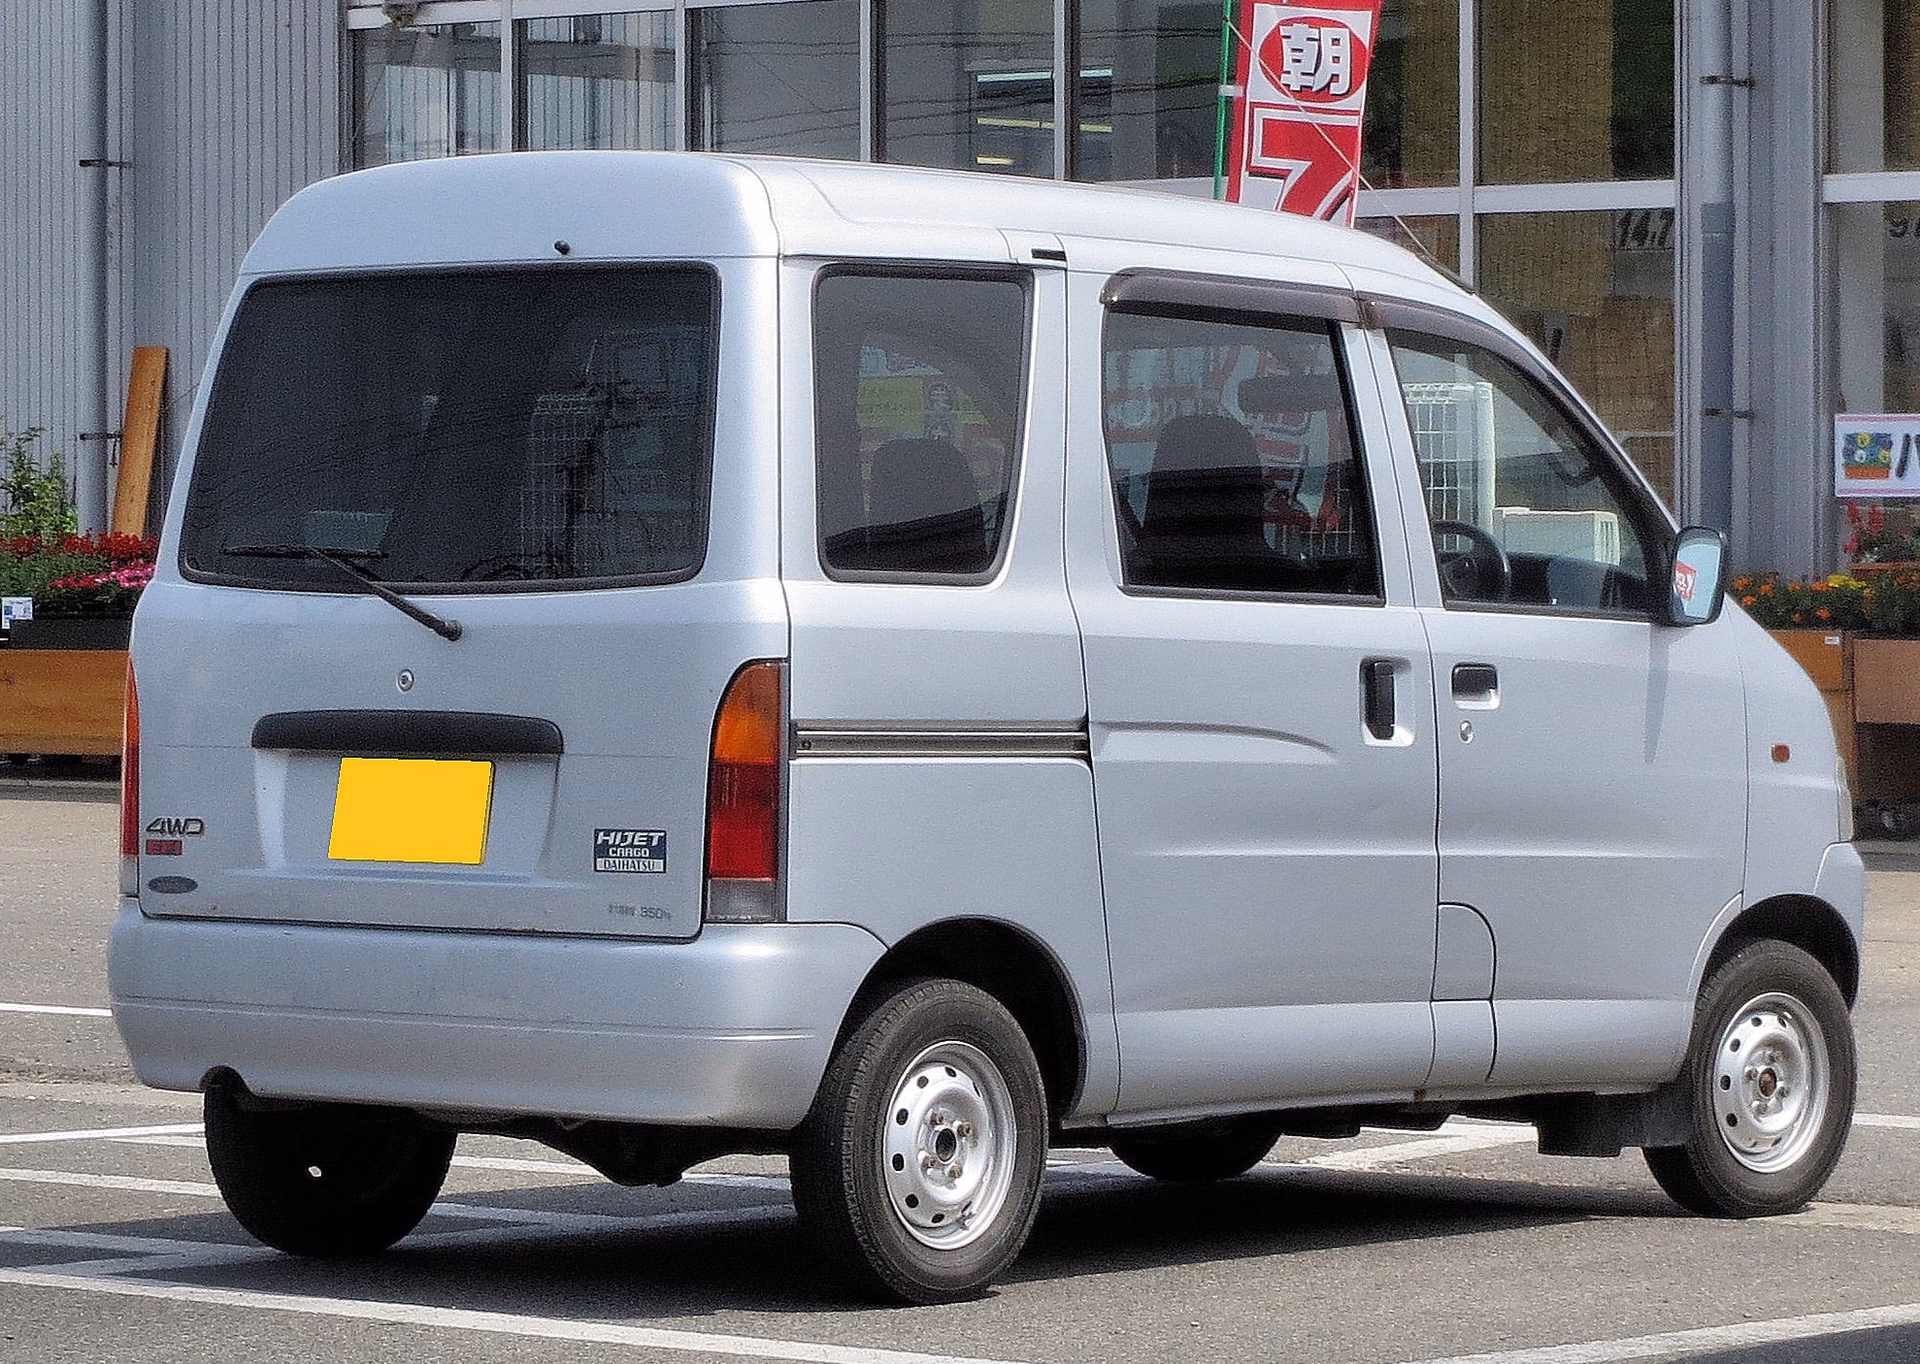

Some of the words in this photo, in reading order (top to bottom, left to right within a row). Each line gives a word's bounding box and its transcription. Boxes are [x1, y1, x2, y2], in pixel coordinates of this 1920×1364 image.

[146, 817, 204, 836] 4WD
[596, 831, 665, 846] HIJET
[608, 847, 650, 857] CARGO
[603, 859, 655, 871] DAIHATSU
